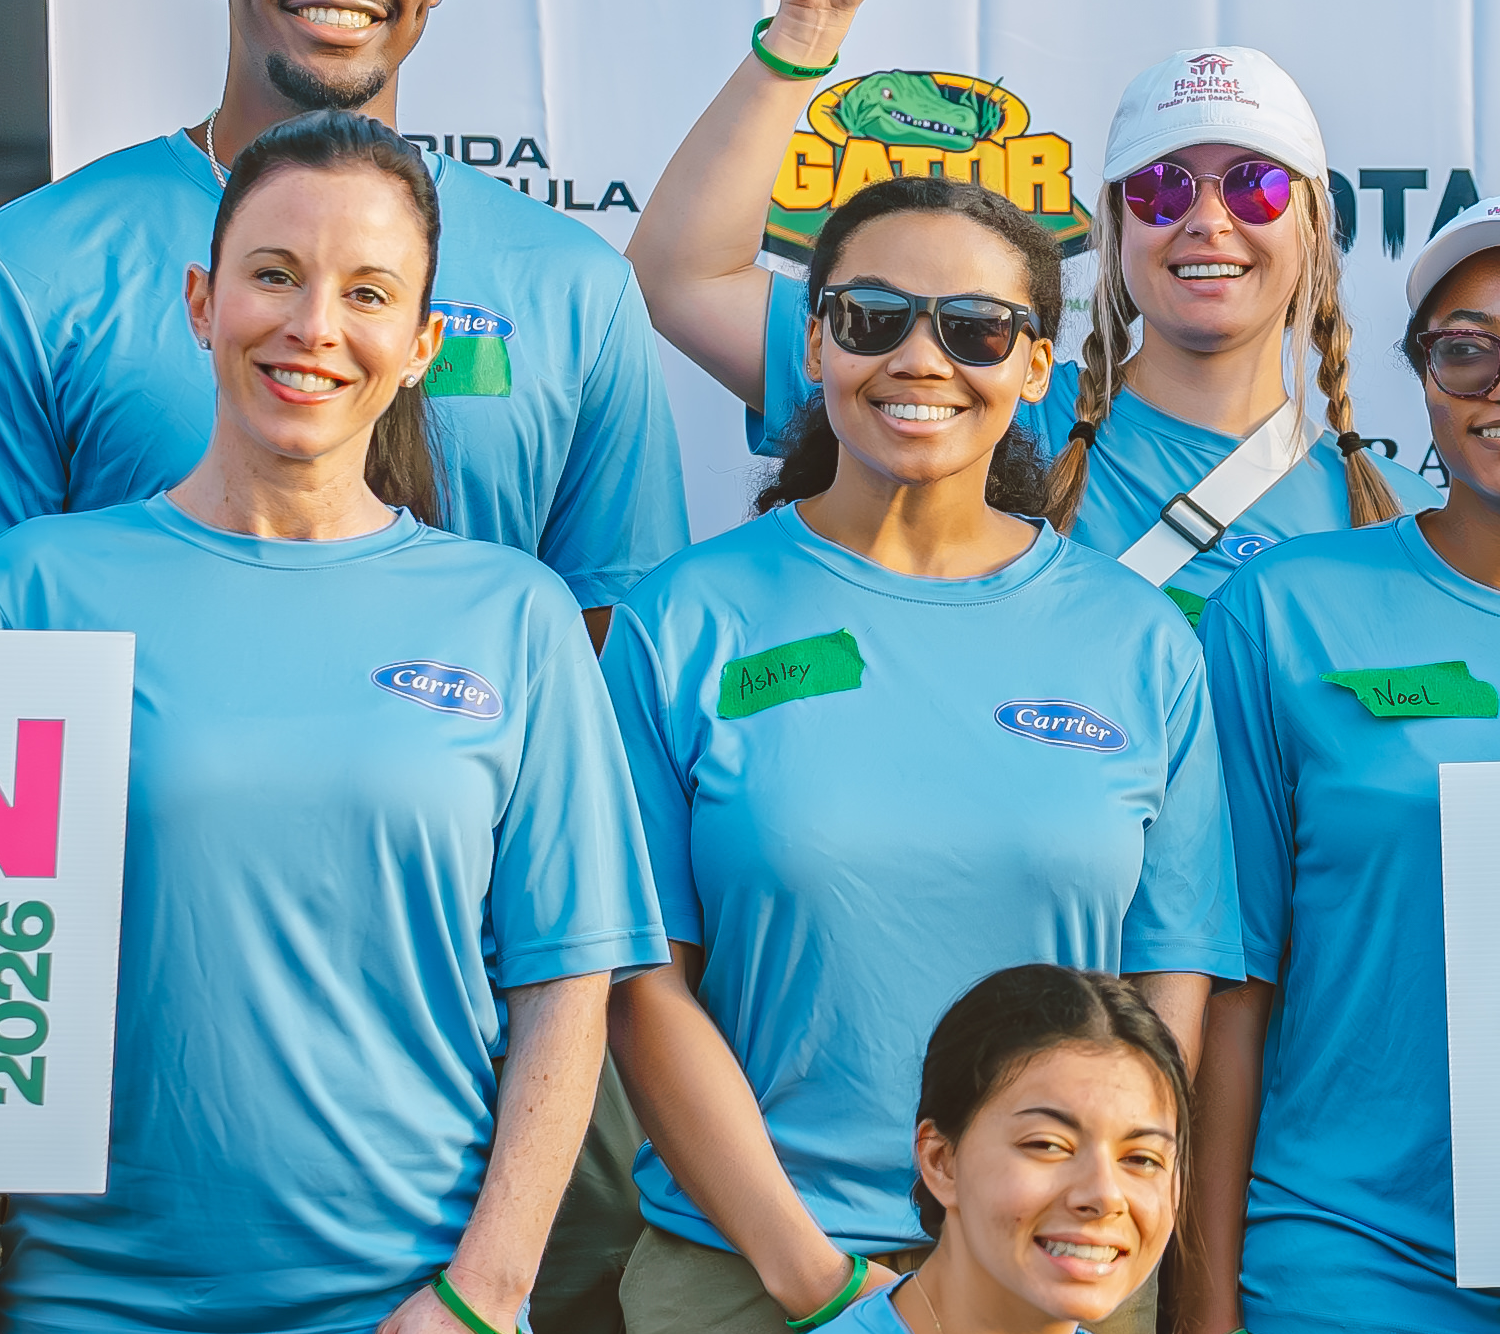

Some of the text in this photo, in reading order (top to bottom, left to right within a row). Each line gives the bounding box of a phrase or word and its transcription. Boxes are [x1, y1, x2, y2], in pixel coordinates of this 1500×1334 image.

[1173, 76, 1241, 91] Habitat
[1186, 95, 1206, 103] Palm
[442, 314, 498, 332] rrier
[393, 669, 490, 706] Carrier
[739, 662, 812, 700] Ashley
[1015, 707, 1112, 742] Carrier
